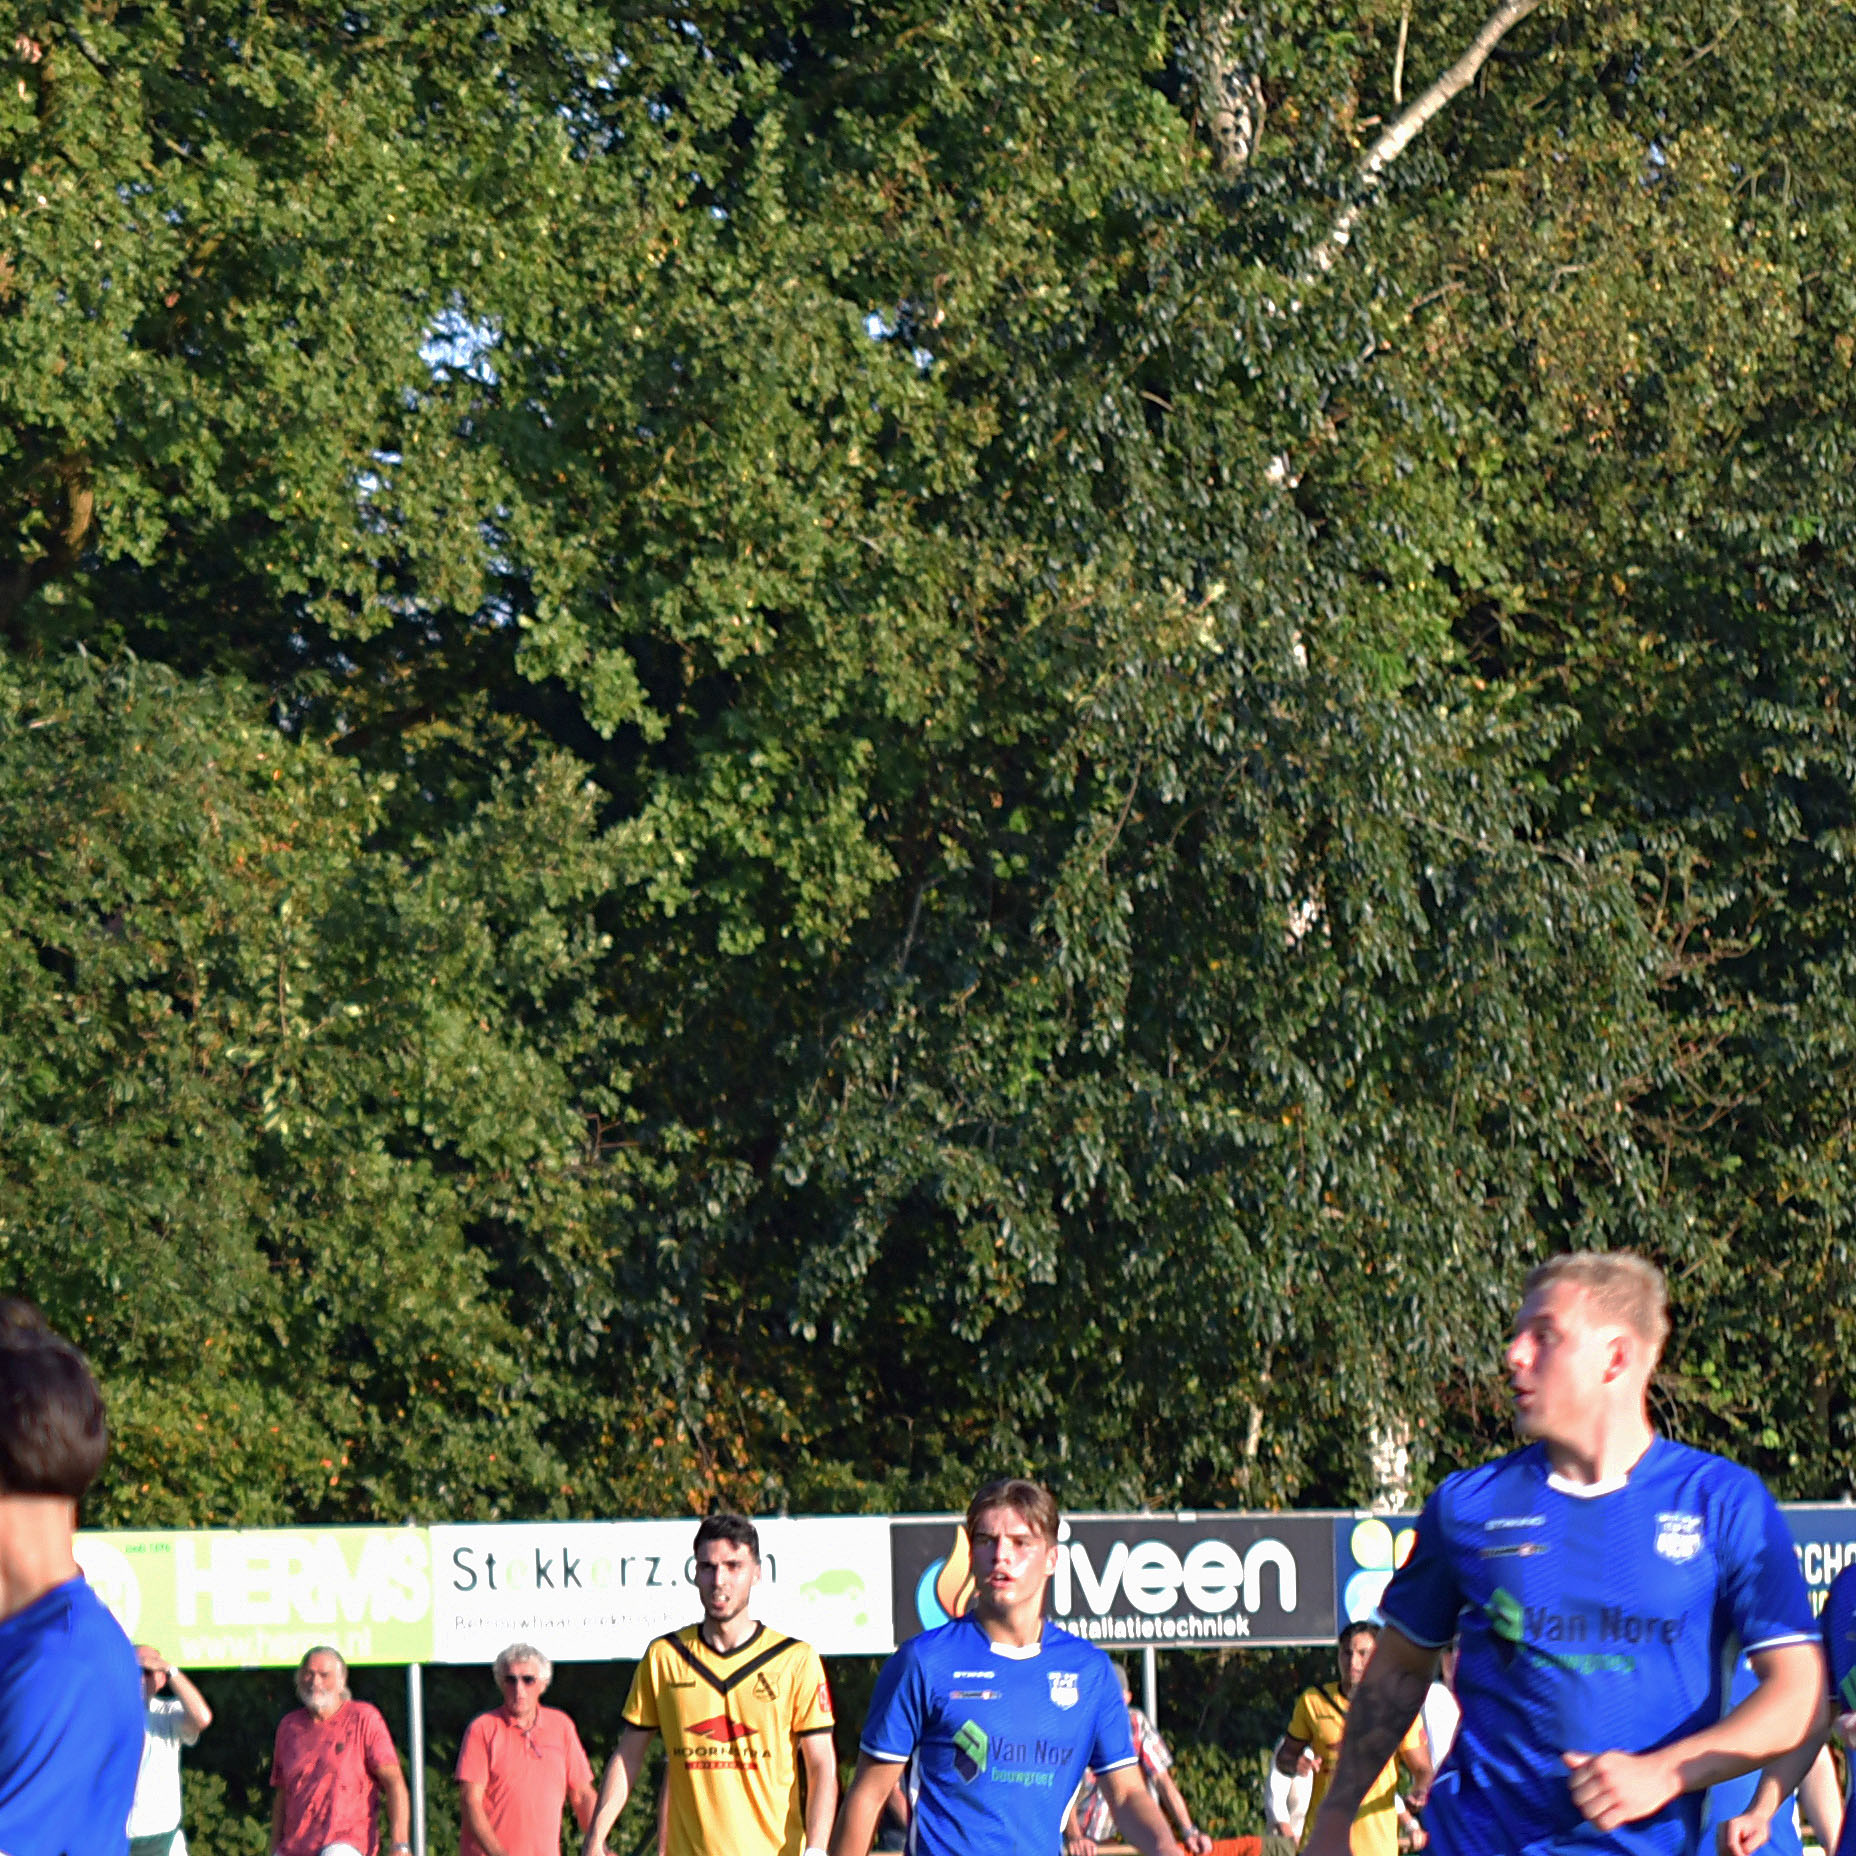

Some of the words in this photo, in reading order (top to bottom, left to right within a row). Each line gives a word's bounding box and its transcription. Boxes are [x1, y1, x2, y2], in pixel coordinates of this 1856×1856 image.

[176, 1534, 429, 1627] HERMS
[1052, 1520, 1297, 1615] iveen
[1054, 1616, 1250, 1638] nstallatietechniek
[1525, 1607, 1586, 1642] Van
[991, 1736, 1026, 1762] Van
